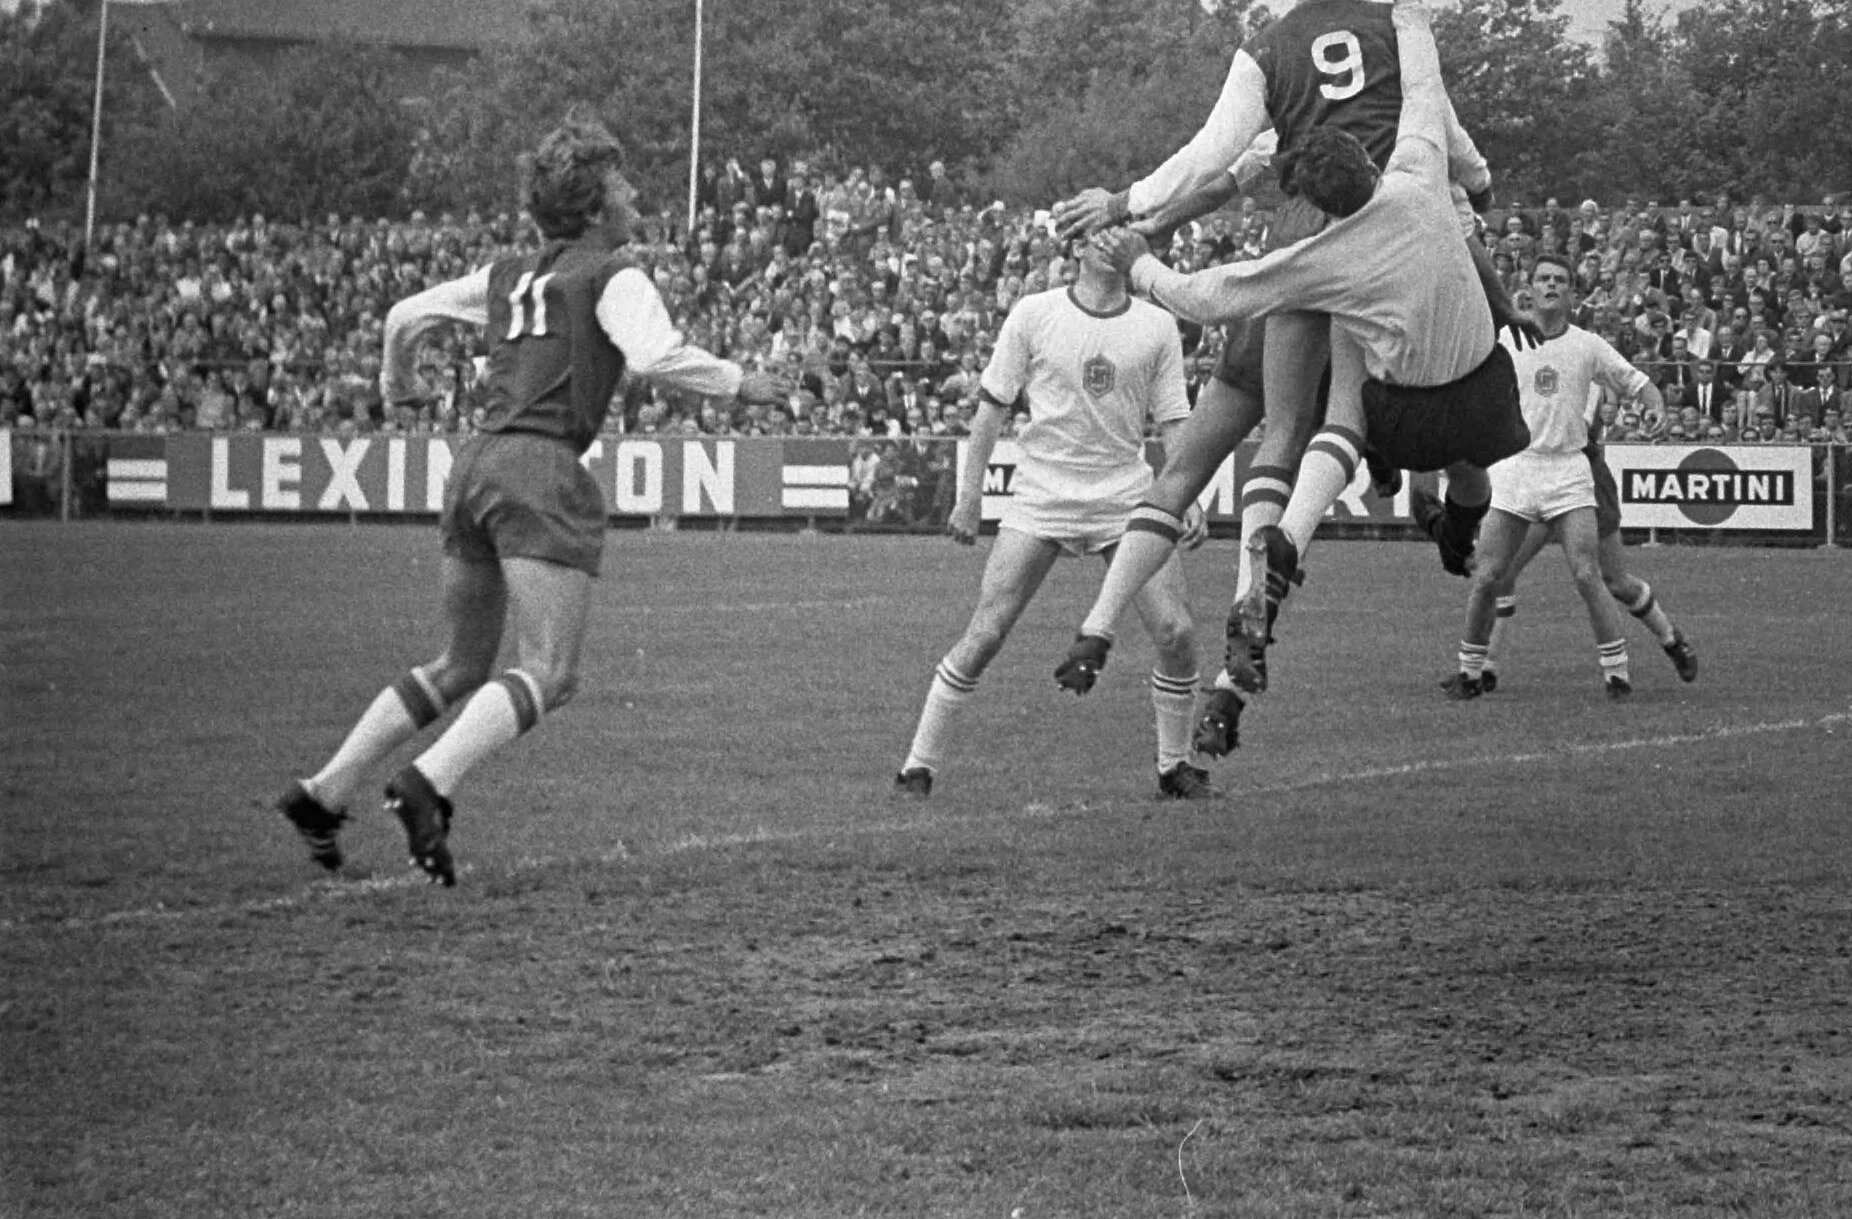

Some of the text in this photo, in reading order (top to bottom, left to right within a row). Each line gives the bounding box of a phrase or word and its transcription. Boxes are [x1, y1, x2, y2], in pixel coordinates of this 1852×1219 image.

[1310, 29, 1366, 101] 9
[505, 270, 557, 340] 11
[210, 437, 736, 514] LEXION
[1631, 472, 1785, 501] MARTINI
